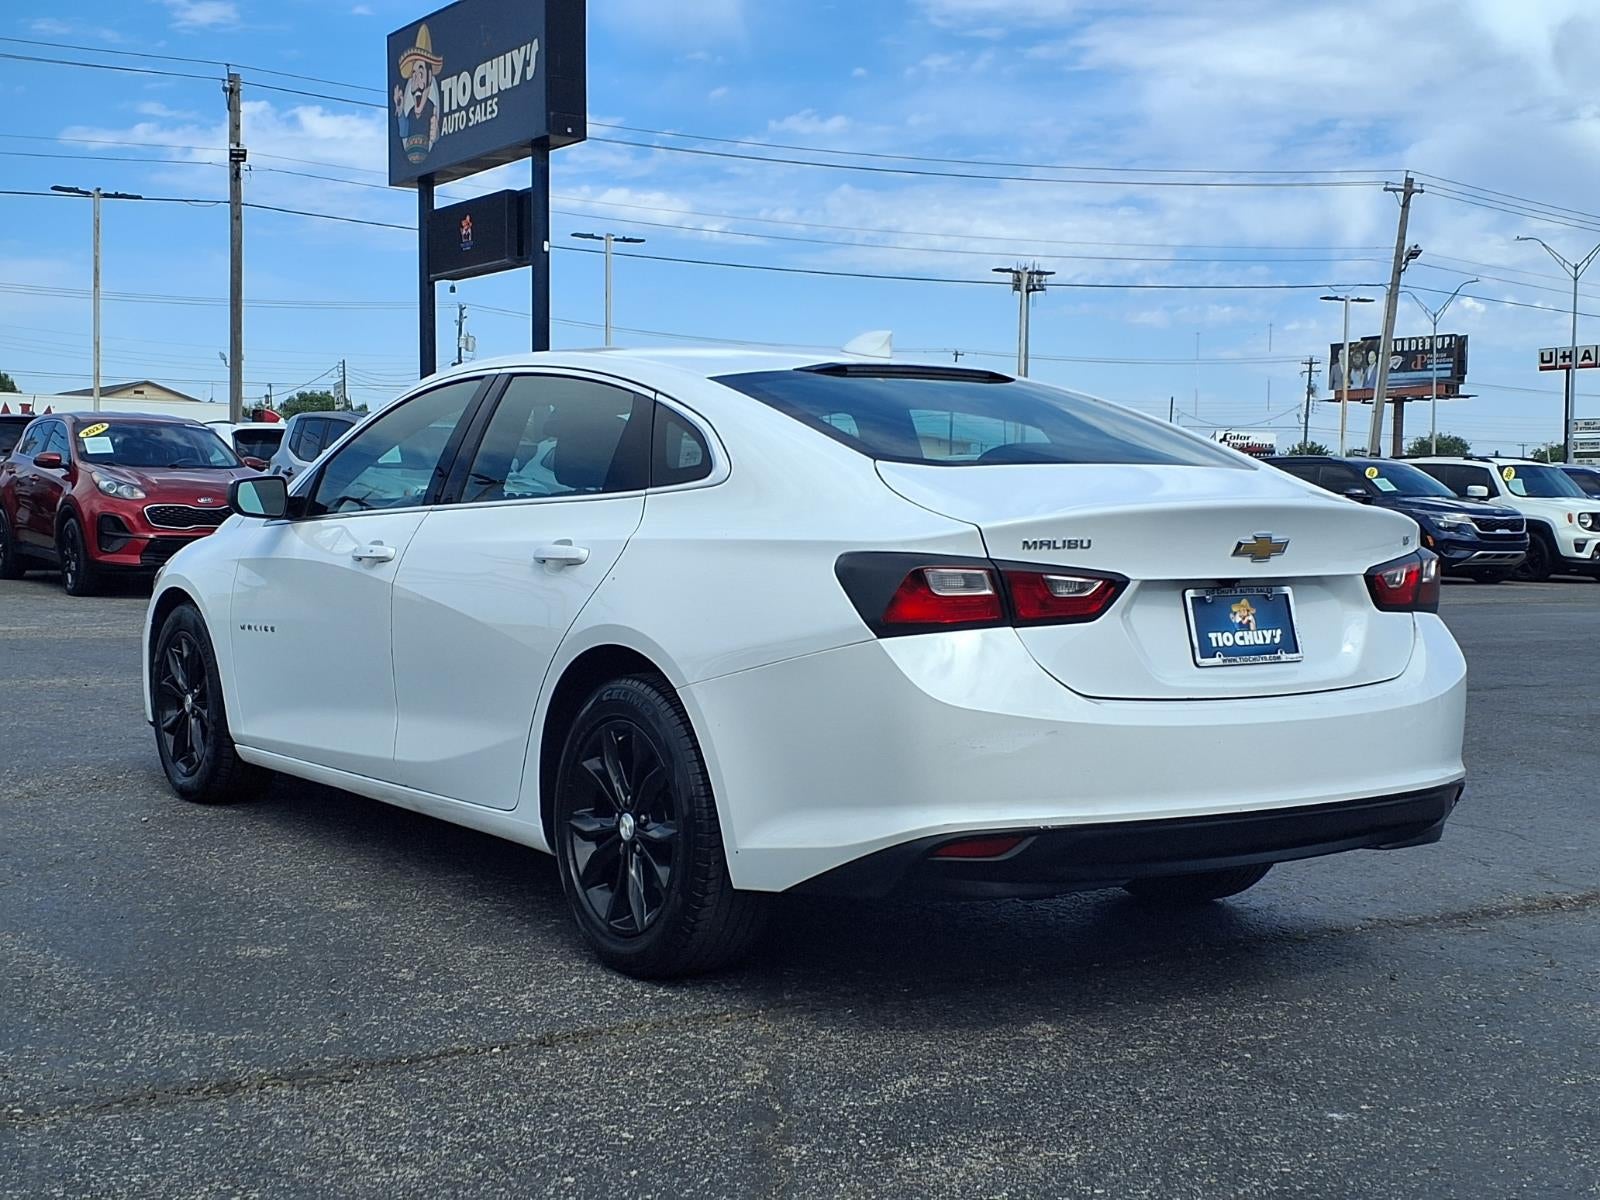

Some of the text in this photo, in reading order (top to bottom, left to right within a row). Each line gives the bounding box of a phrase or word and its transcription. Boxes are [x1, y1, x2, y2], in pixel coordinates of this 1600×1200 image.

[441, 38, 539, 113] TIO CHUY'S
[441, 97, 498, 136] AUTO SALES
[1391, 336, 1455, 352] UNDER UP!
[1022, 538, 1092, 551] MALIBU
[1208, 628, 1282, 647] TIO CHUY'S
